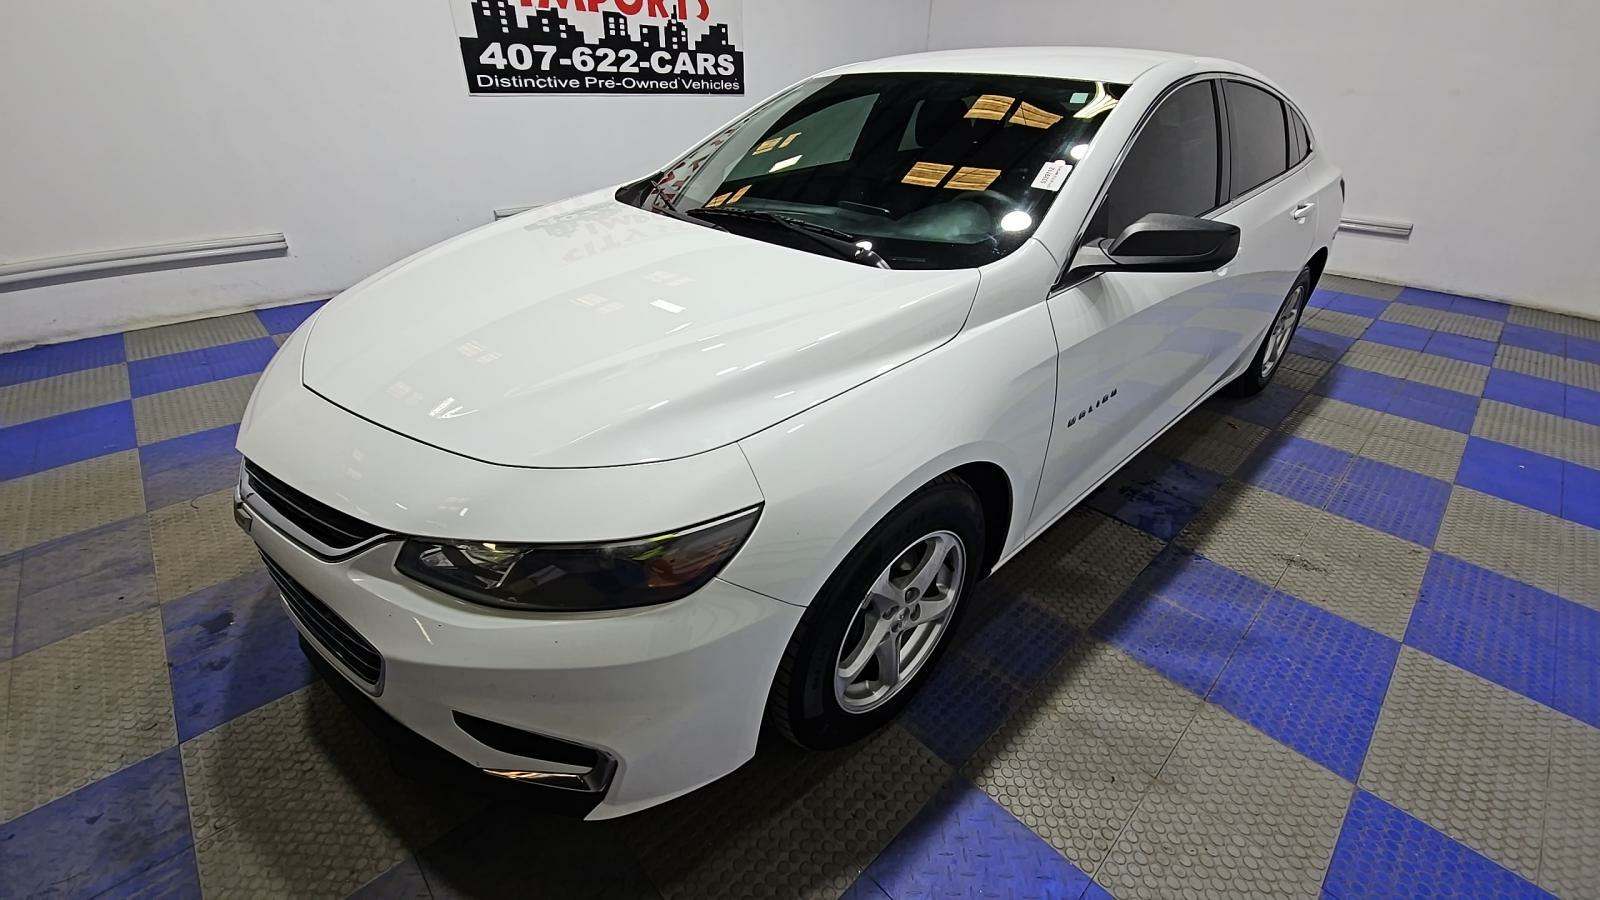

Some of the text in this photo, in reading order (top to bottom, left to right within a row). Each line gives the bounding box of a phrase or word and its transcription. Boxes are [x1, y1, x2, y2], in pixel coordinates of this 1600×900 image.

[479, 42, 735, 76] 407-622-CARS
[476, 74, 740, 90] Distinctive Pre-Owned Vehicles
